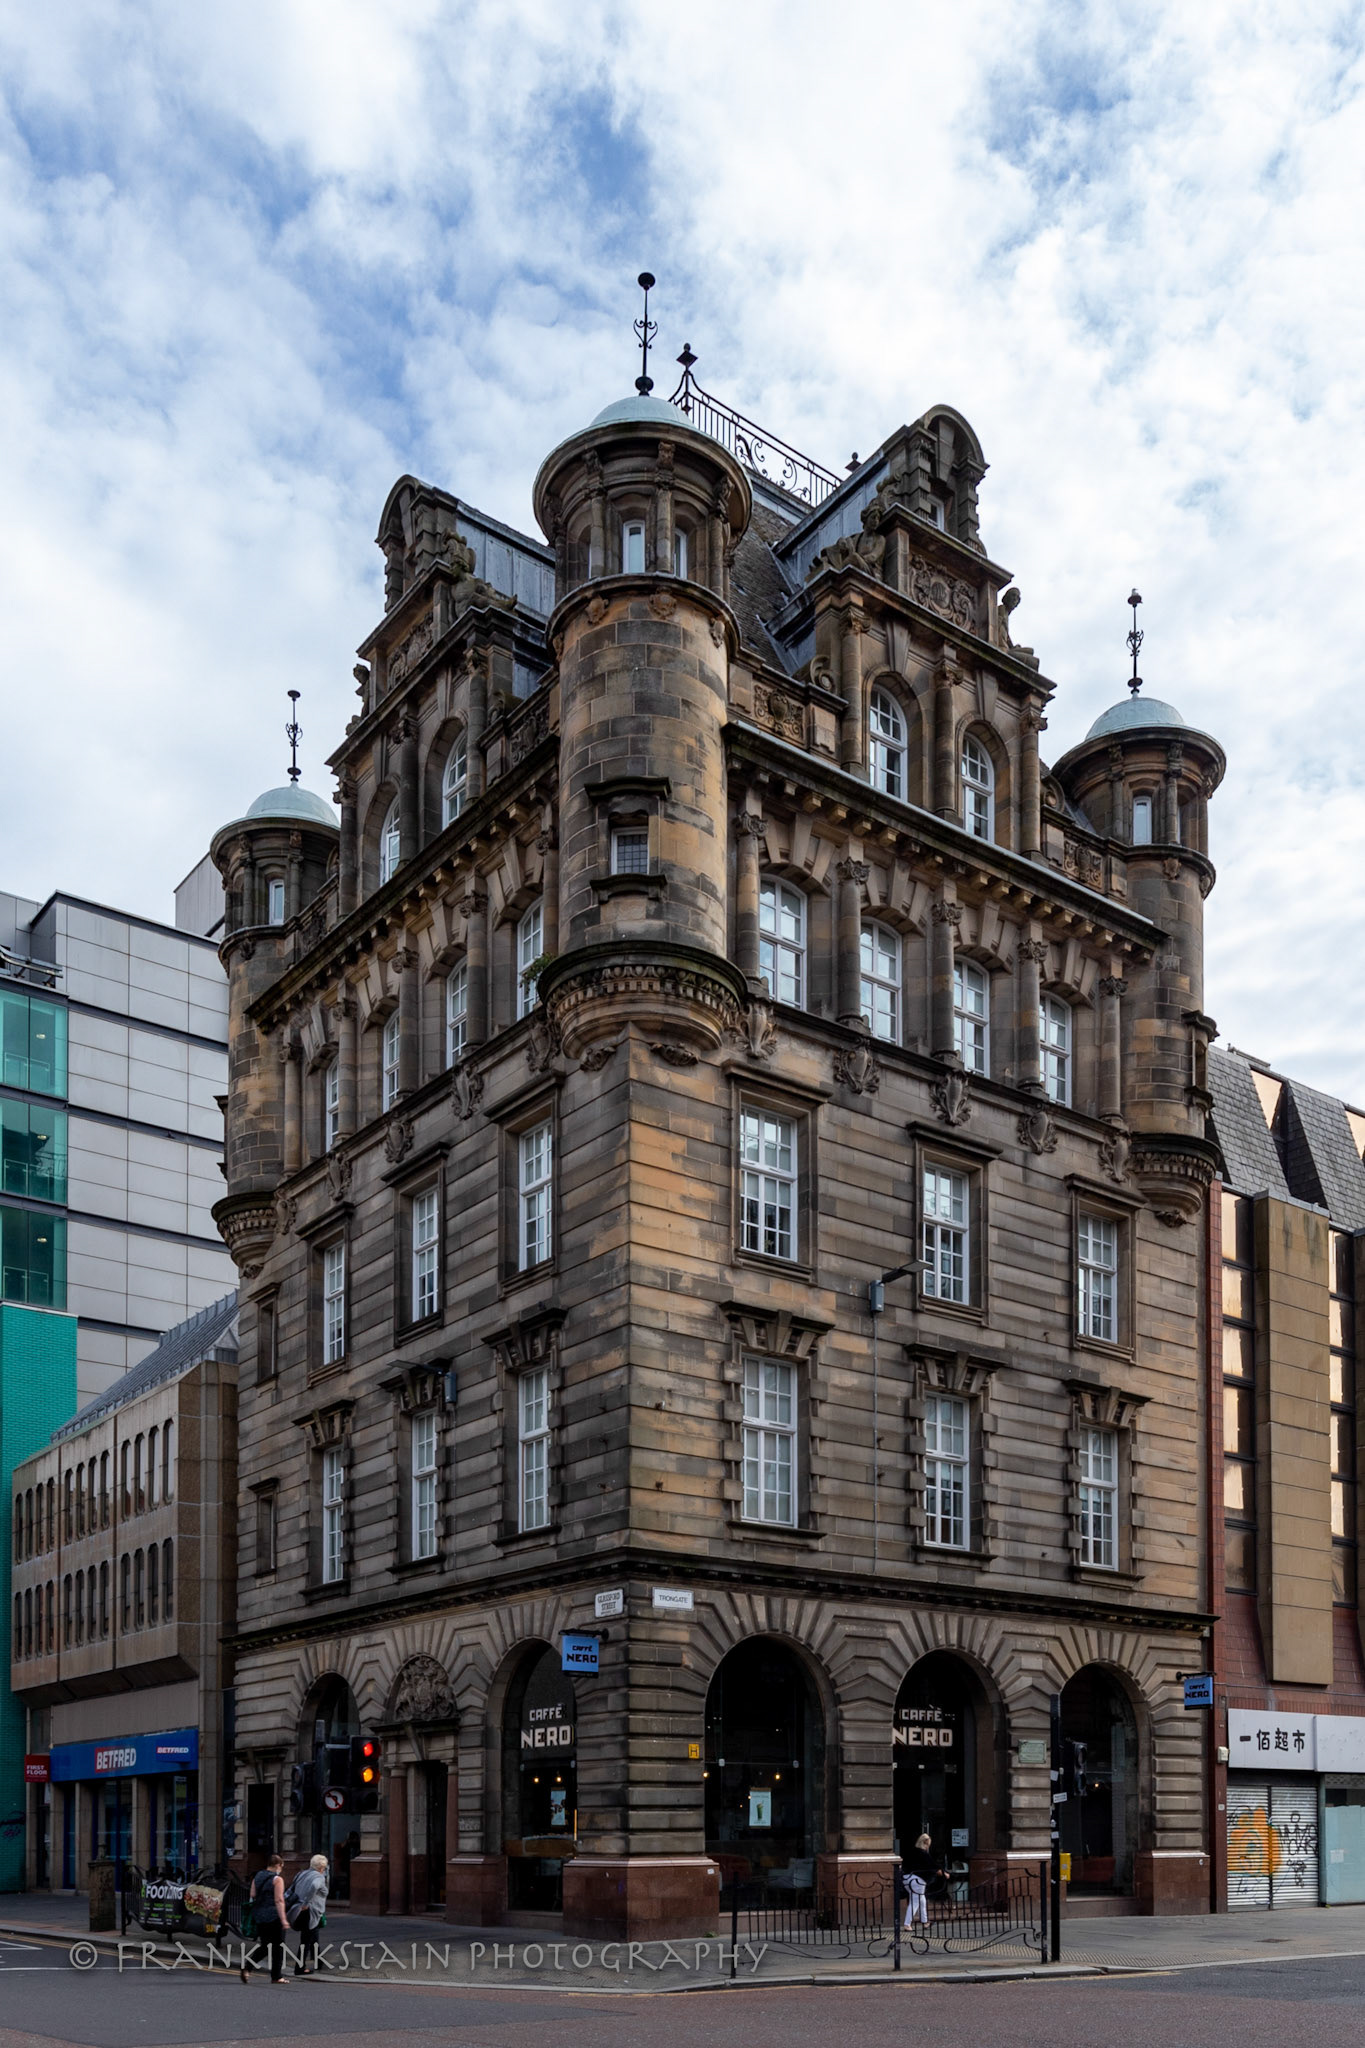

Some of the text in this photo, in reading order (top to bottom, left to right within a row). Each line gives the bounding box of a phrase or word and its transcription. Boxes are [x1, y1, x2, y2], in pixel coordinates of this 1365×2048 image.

[658, 1594, 689, 1604] TRONGATE
[601, 1601, 616, 1611] STREET
[566, 1653, 598, 1663] NERO
[1184, 1690, 1209, 1699] NERO
[520, 1725, 571, 1749] NERO
[892, 1726, 953, 1747] NERO
[1239, 1727, 1306, 1753] 一佰超市
[157, 1746, 189, 1754] BETFRED
[690, 1745, 698, 1757] H
[96, 1747, 137, 1770] BETFRED
